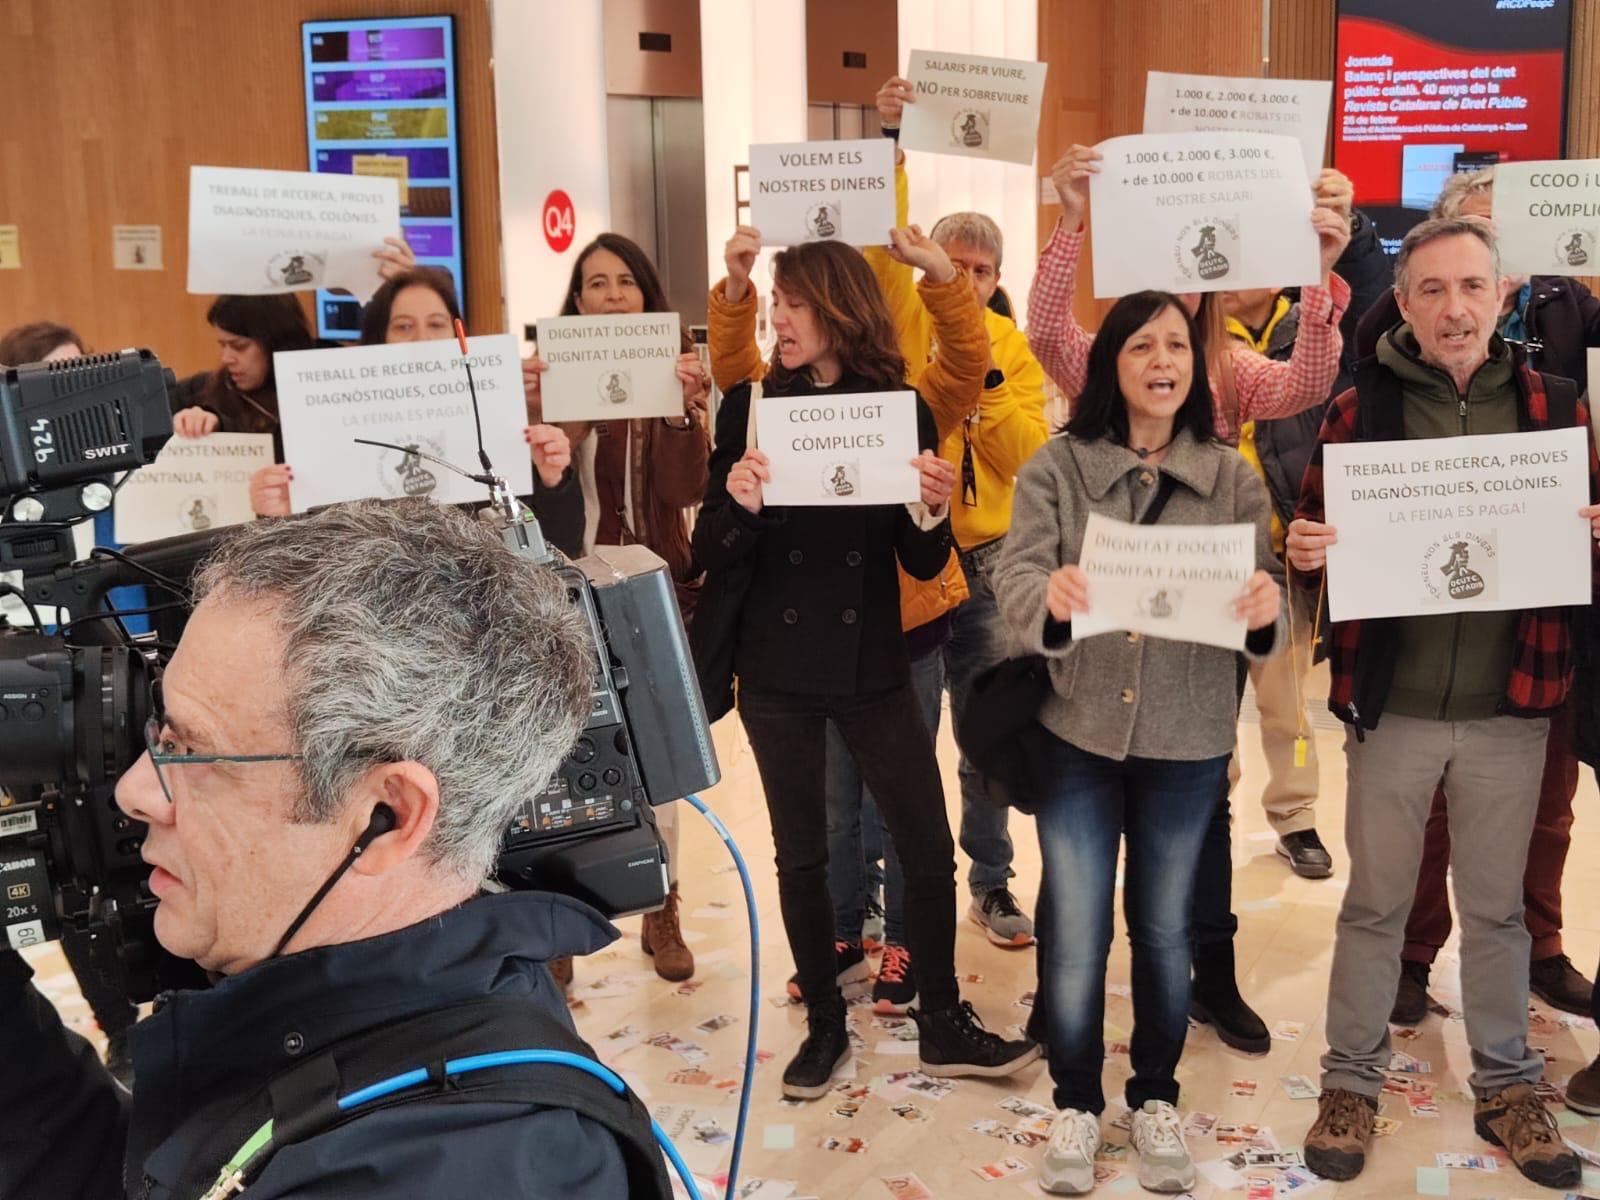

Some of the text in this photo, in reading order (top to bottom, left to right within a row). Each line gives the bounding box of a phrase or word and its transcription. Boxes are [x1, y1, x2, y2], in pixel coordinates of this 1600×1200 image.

[925, 59, 966, 73] SALARIS
[968, 64, 989, 75] PER
[1344, 54, 1394, 67] Jornada
[1344, 70, 1386, 84] Balanç
[1393, 67, 1468, 83] perspectives
[1470, 66, 1490, 78] del
[1491, 66, 1517, 78] dret
[916, 81, 1029, 104] NO PER SOBREVIURE
[1176, 89, 1203, 100] 1.000
[1217, 91, 1246, 101] 2.000
[1260, 93, 1289, 104] 3.000
[1344, 85, 1380, 99] públic
[1422, 83, 1438, 95] 40
[1438, 85, 1468, 97] anys
[1470, 82, 1486, 94] de
[1487, 82, 1500, 94] la
[1344, 96, 1527, 112] Revista Catalana de Dret Públic
[1178, 106, 1191, 116] de
[1194, 108, 1228, 119] 10.000
[1230, 110, 1238, 119] €
[1239, 110, 1281, 122] ROBATS
[779, 151, 863, 167] VOLEM ELS
[1125, 152, 1159, 164] 1.000
[1162, 152, 1174, 163] €,
[1177, 150, 1210, 162] 2.000
[1214, 150, 1226, 161] €,
[1228, 148, 1261, 160] 3.000
[759, 176, 886, 194] NOSTRES DINERS
[1133, 175, 1149, 186] de
[1152, 172, 1194, 185] 10.000
[1197, 171, 1205, 182] €
[1207, 168, 1258, 182] ROBATS
[1260, 167, 1283, 179] DEL
[1530, 173, 1580, 188] CCOO
[1584, 172, 1590, 188] i
[209, 185, 259, 199] TREBALL
[263, 188, 279, 200] DE
[341, 191, 385, 205] PROVES
[1156, 193, 1208, 207] NOSTRE
[1529, 199, 1600, 217] CÒMPLI
[545, 206, 573, 238] Q4
[548, 323, 671, 341] DIGNITAT DOCENT!
[547, 346, 675, 363] DIGNITAT LABORAL!
[297, 353, 503, 383] TREBALL DE RECERCA, PROVES
[305, 386, 425, 407] DIAGNÒSTIQUES,
[342, 404, 470, 428] LA FEINA ES PAGA!
[789, 405, 884, 423] CCOO i UGT
[30, 418, 56, 464] 924
[792, 433, 885, 452] CÒMPLICES
[85, 443, 131, 459] SWIT
[1343, 449, 1569, 478] TREBALL DE RECERCA, PROVES
[1351, 475, 1562, 502] DIAGNÒSTIQUES, COLÒNIES.
[1388, 501, 1527, 524] LA FEINA ES PAGA!
[1095, 531, 1171, 554] DIGNITAT
[1465, 532, 1496, 559] DINERS
[1085, 559, 1162, 579] DIGNITAT
[11, 886, 27, 897] 4K
